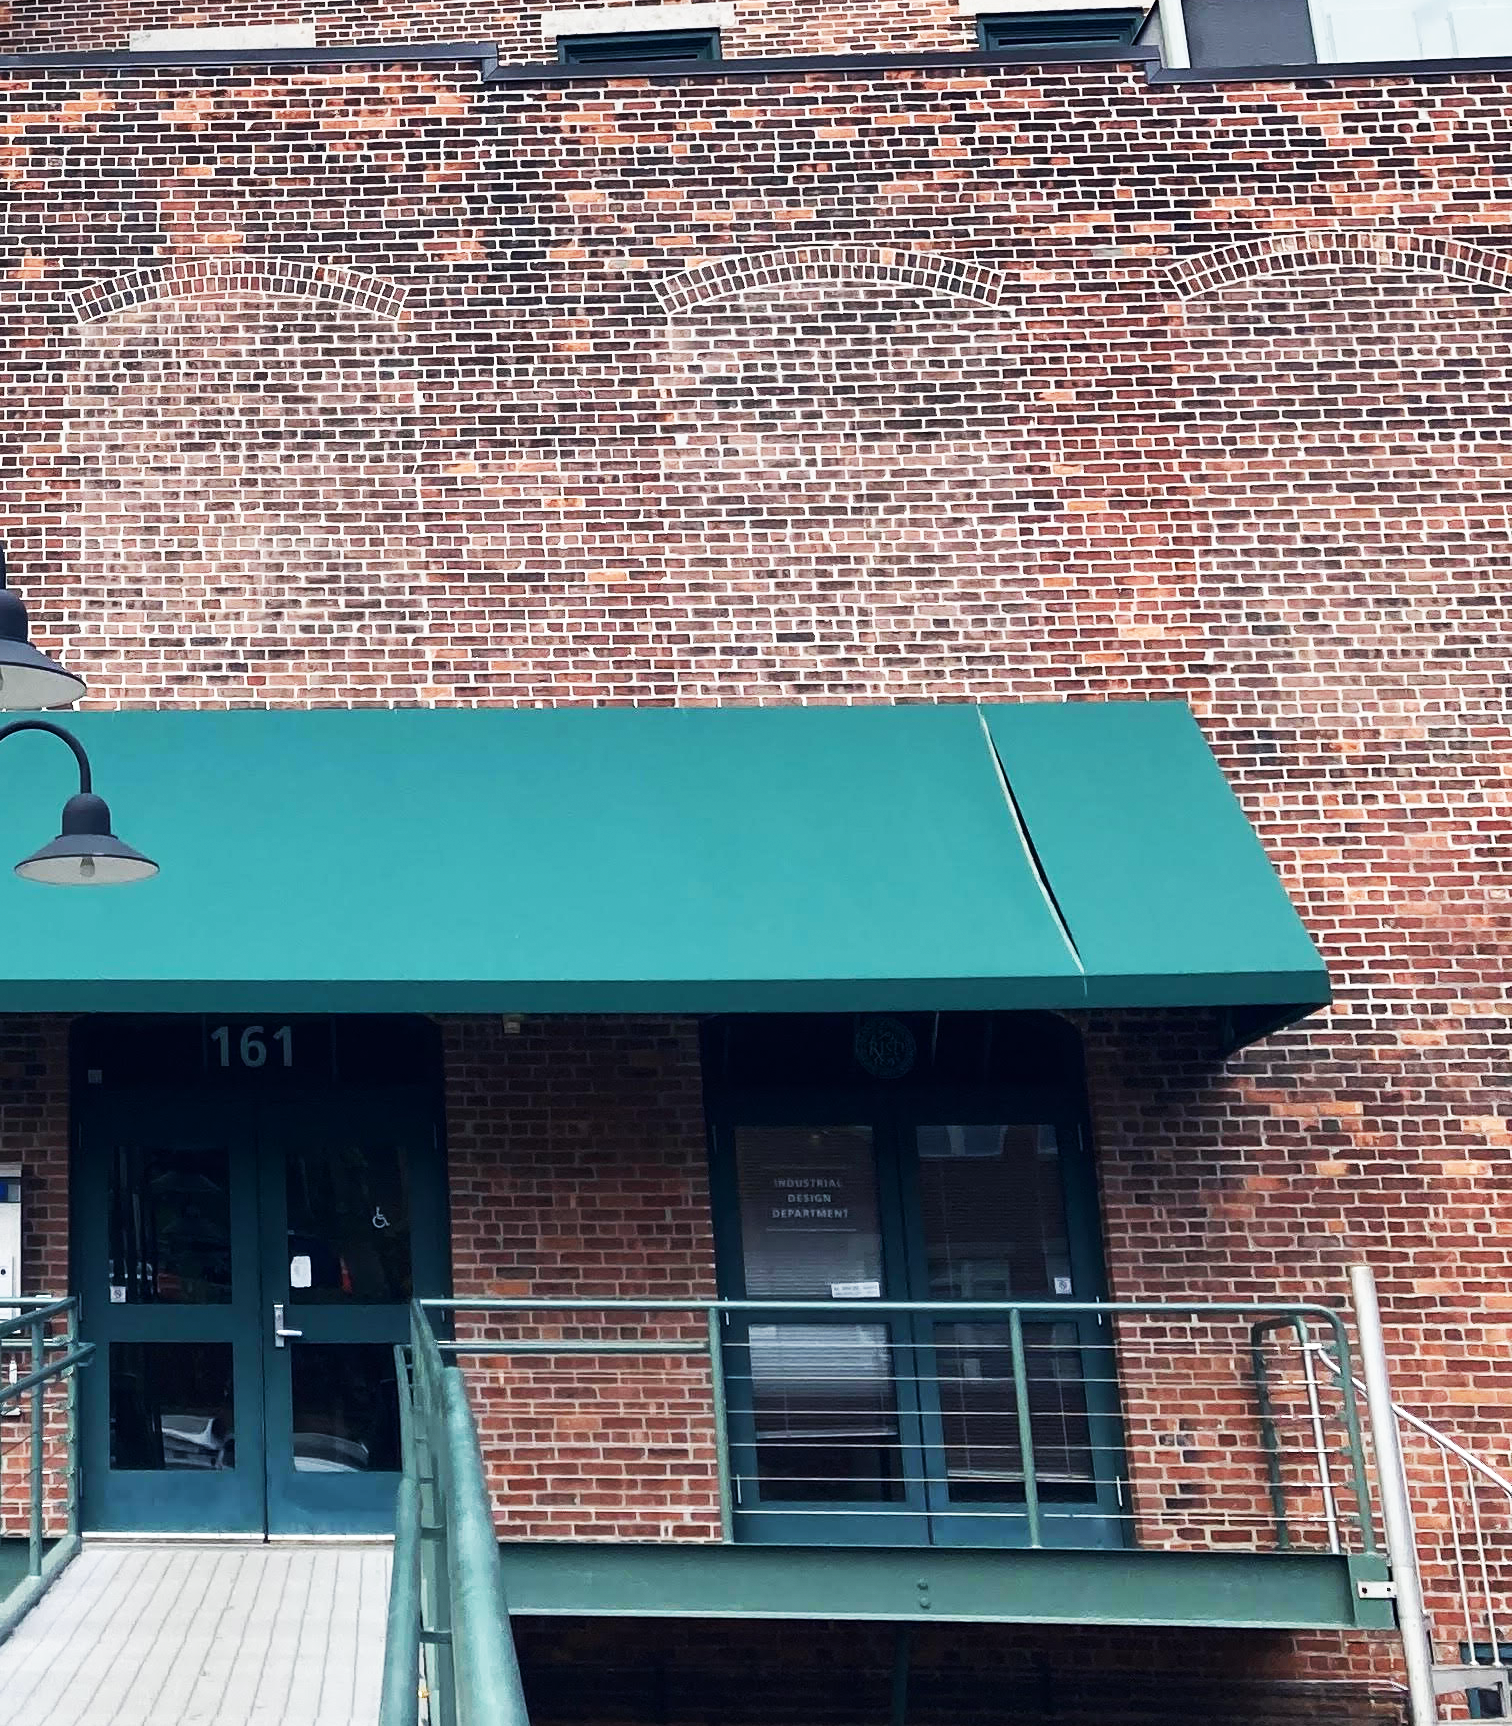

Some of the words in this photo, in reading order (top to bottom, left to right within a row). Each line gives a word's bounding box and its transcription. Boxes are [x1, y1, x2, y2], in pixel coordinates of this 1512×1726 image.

[210, 1025, 293, 1067] 161
[774, 1178, 842, 1188] INDUSTRIAL
[787, 1193, 832, 1203] DESIGN
[771, 1208, 849, 1219] DEPARTMENT
